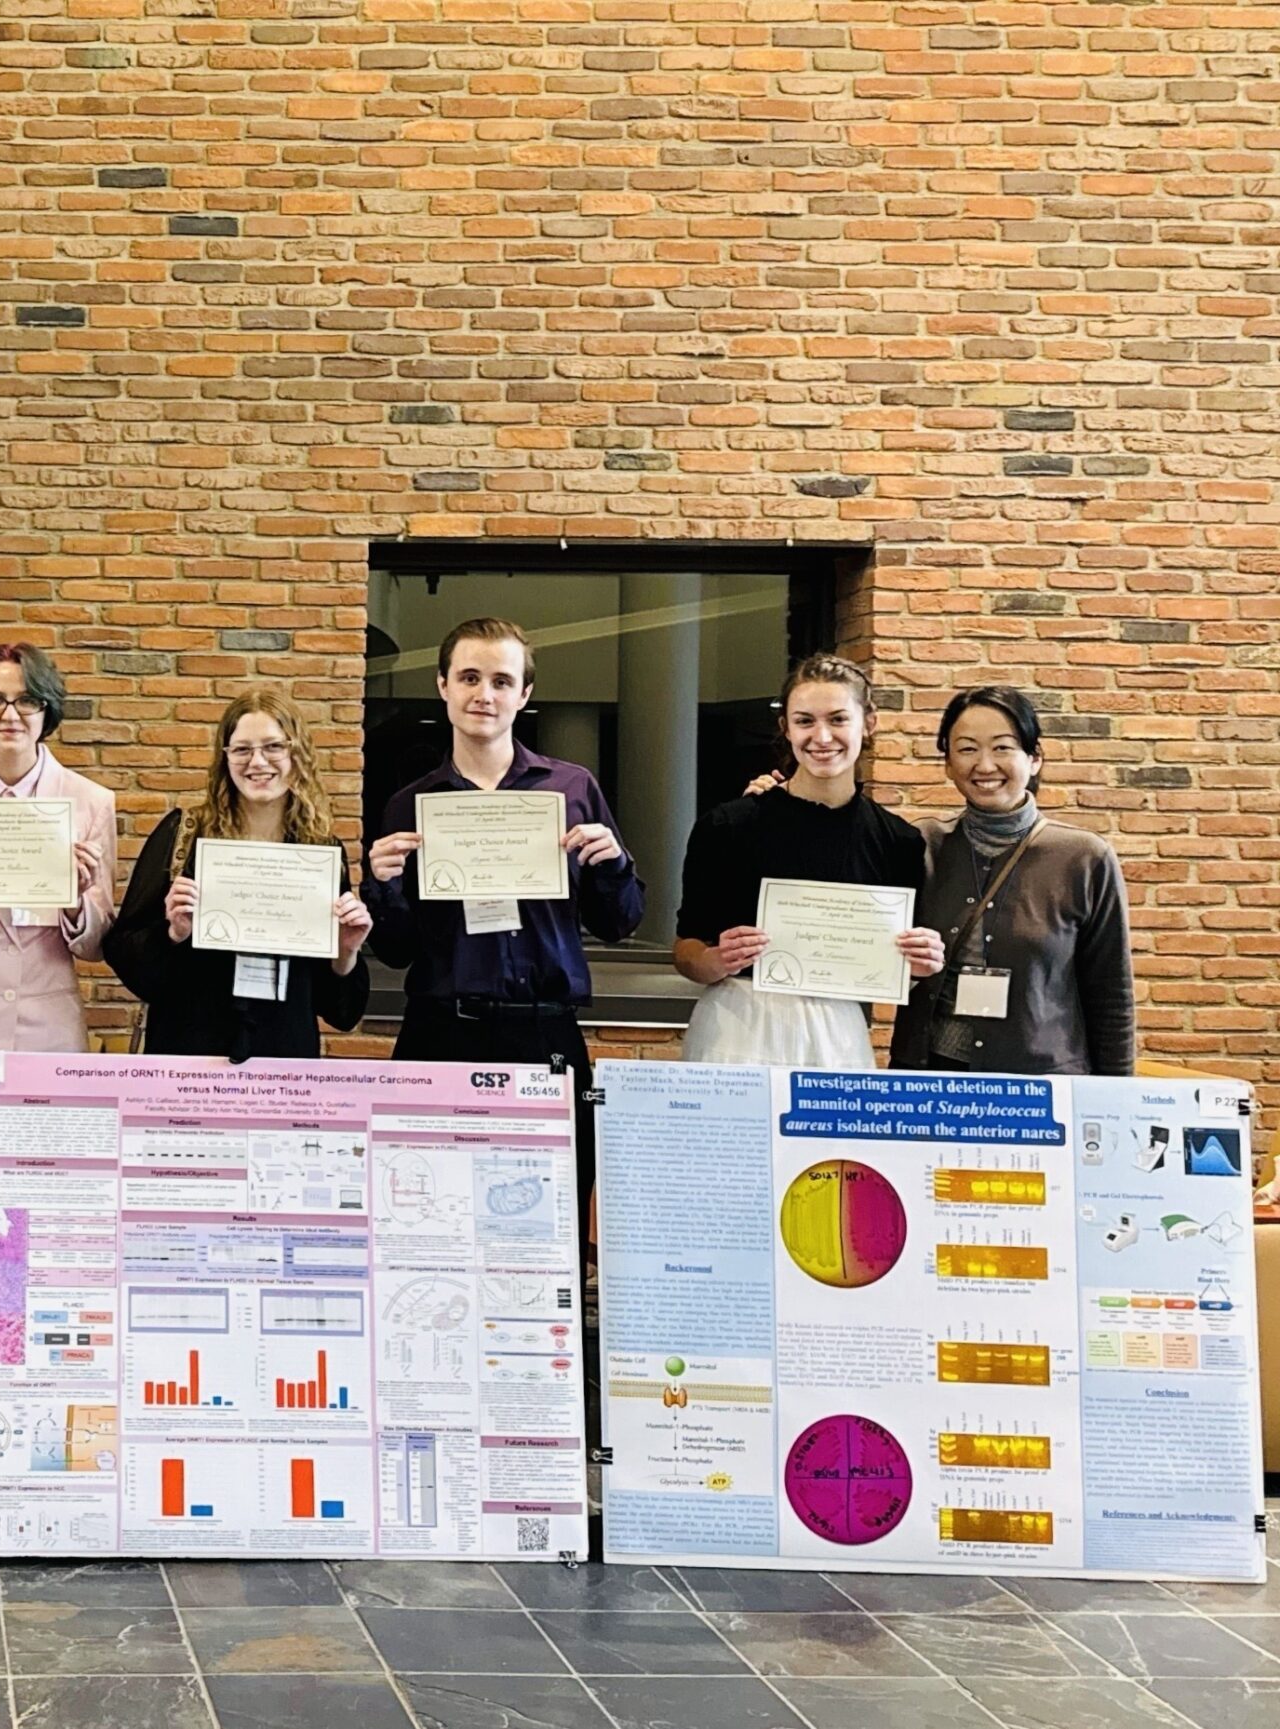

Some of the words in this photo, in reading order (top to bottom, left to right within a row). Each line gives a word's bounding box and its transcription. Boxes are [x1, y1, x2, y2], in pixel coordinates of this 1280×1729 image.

[480, 838, 504, 846] Choice
[282, 893, 303, 902] Award
[850, 935, 874, 945] Award
[55, 1068, 116, 1078] Comparison
[118, 1068, 129, 1079] of
[132, 1069, 166, 1079] ORNT1
[168, 1070, 224, 1080] Expression
[226, 1071, 236, 1081] in
[238, 1072, 303, 1081] Fibrolamellar
[305, 1073, 376, 1083] Hepatocellular
[378, 1075, 432, 1084] Carcinoma
[470, 1072, 510, 1088] CSP
[530, 1072, 549, 1082] SCI
[796, 1074, 889, 1093] Investigating
[892, 1082, 902, 1092] a
[906, 1079, 943, 1093] novel
[946, 1081, 1003, 1095] deletion
[1006, 1082, 1020, 1096] in
[1024, 1083, 1046, 1096] the
[178, 1086, 210, 1094] versus
[213, 1087, 249, 1095] Normal
[251, 1087, 277, 1096] Liver
[279, 1088, 312, 1096] Tissue
[520, 1086, 561, 1097] 455/456
[1142, 1095, 1176, 1104] Methods
[1215, 1098, 1222, 1106] P
[1224, 1098, 1237, 1106] 22
[669, 1100, 702, 1110] Abstract
[798, 1098, 861, 1112] mannitol
[865, 1102, 914, 1115] operon
[918, 1101, 934, 1114] of
[936, 1101, 1047, 1118] Staphylococcus
[786, 1120, 833, 1131] aureus
[836, 1119, 892, 1134] isolated
[895, 1121, 930, 1136] from
[934, 1123, 957, 1136] the
[960, 1124, 1018, 1138] anterior
[1020, 1128, 1061, 1140] nares
[150, 1170, 218, 1178] Hypothesis/Objective
[664, 1264, 712, 1274] Background
[1145, 1388, 1190, 1398] Conclusion
[712, 1478, 727, 1486] ATP
[515, 1504, 552, 1512] References
[1102, 1510, 1146, 1519] References
[1148, 1511, 1162, 1520] and
